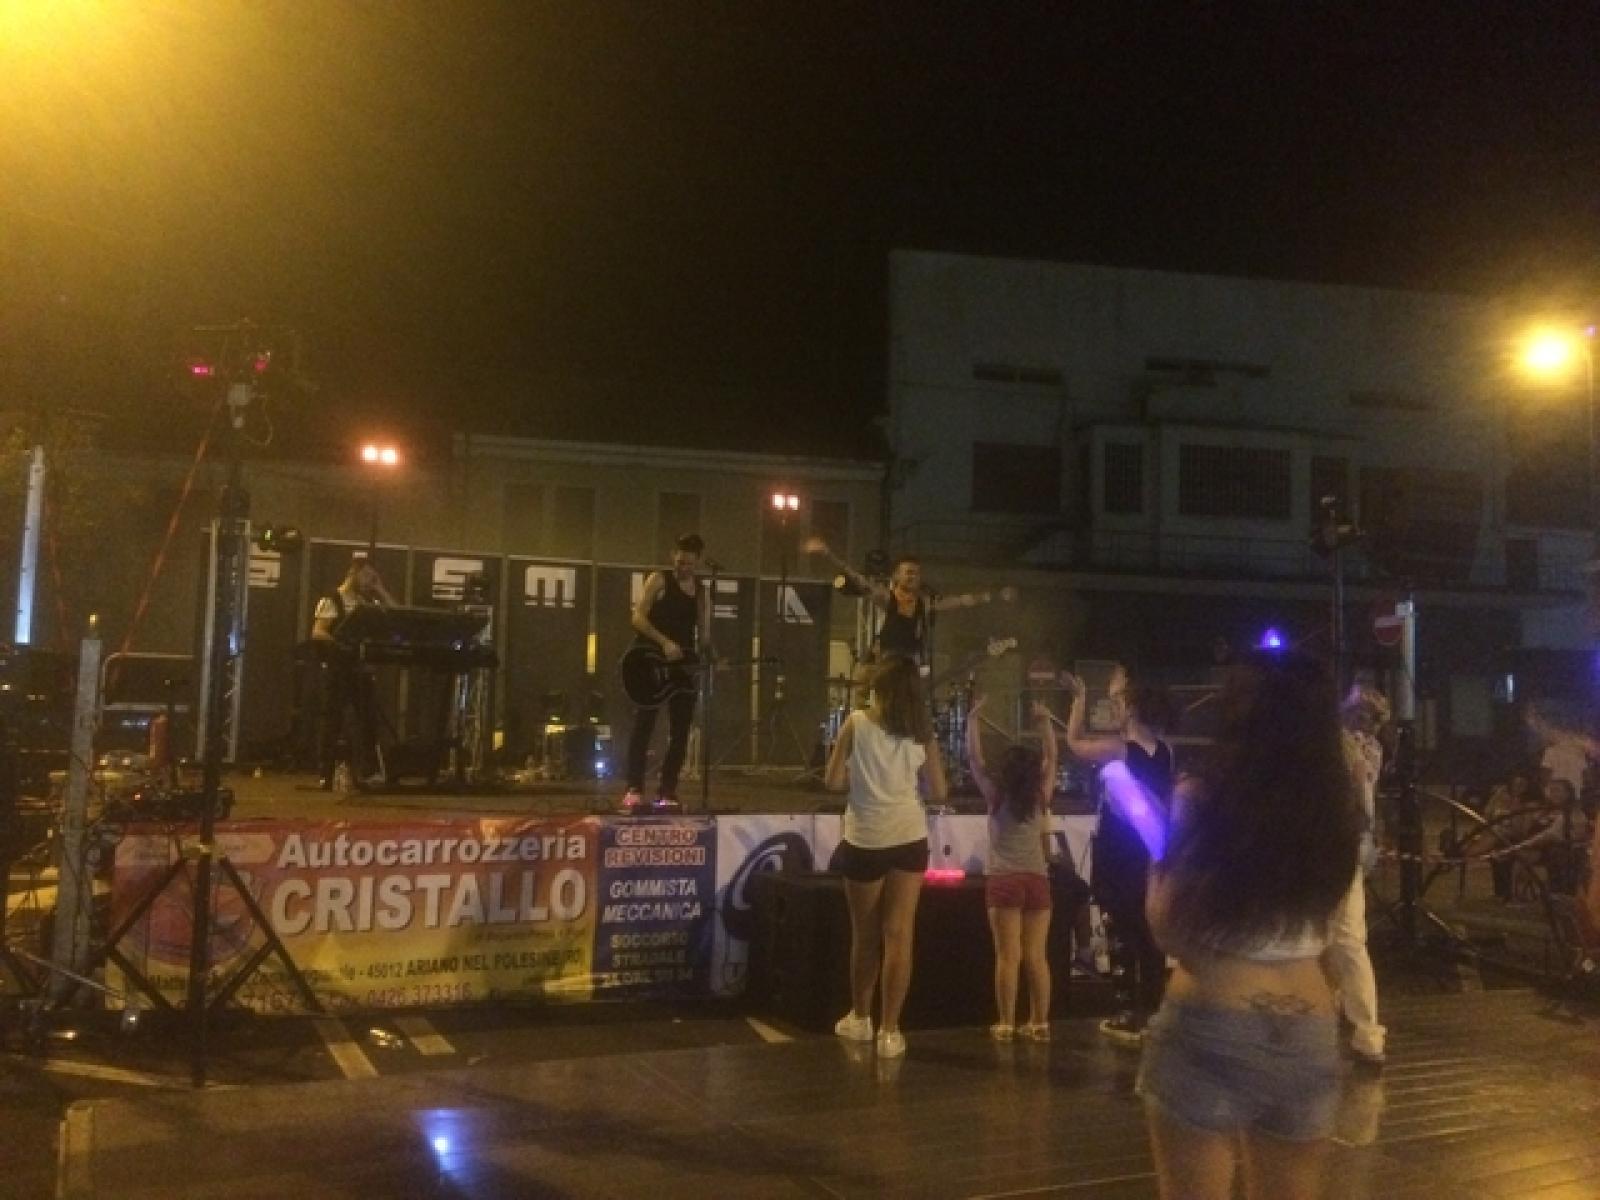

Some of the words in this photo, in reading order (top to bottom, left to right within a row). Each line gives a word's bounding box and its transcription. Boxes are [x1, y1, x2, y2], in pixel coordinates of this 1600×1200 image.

[616, 827, 698, 845] CENTRO
[276, 831, 588, 870] Autocarrozzeria
[606, 847, 705, 866] REVISIONI
[609, 878, 698, 898] GOMMISTA
[271, 868, 588, 934] CRISTALLO
[602, 901, 702, 923] MECCANICA
[407, 955, 459, 976] ARIANO
[463, 953, 489, 971] NEL
